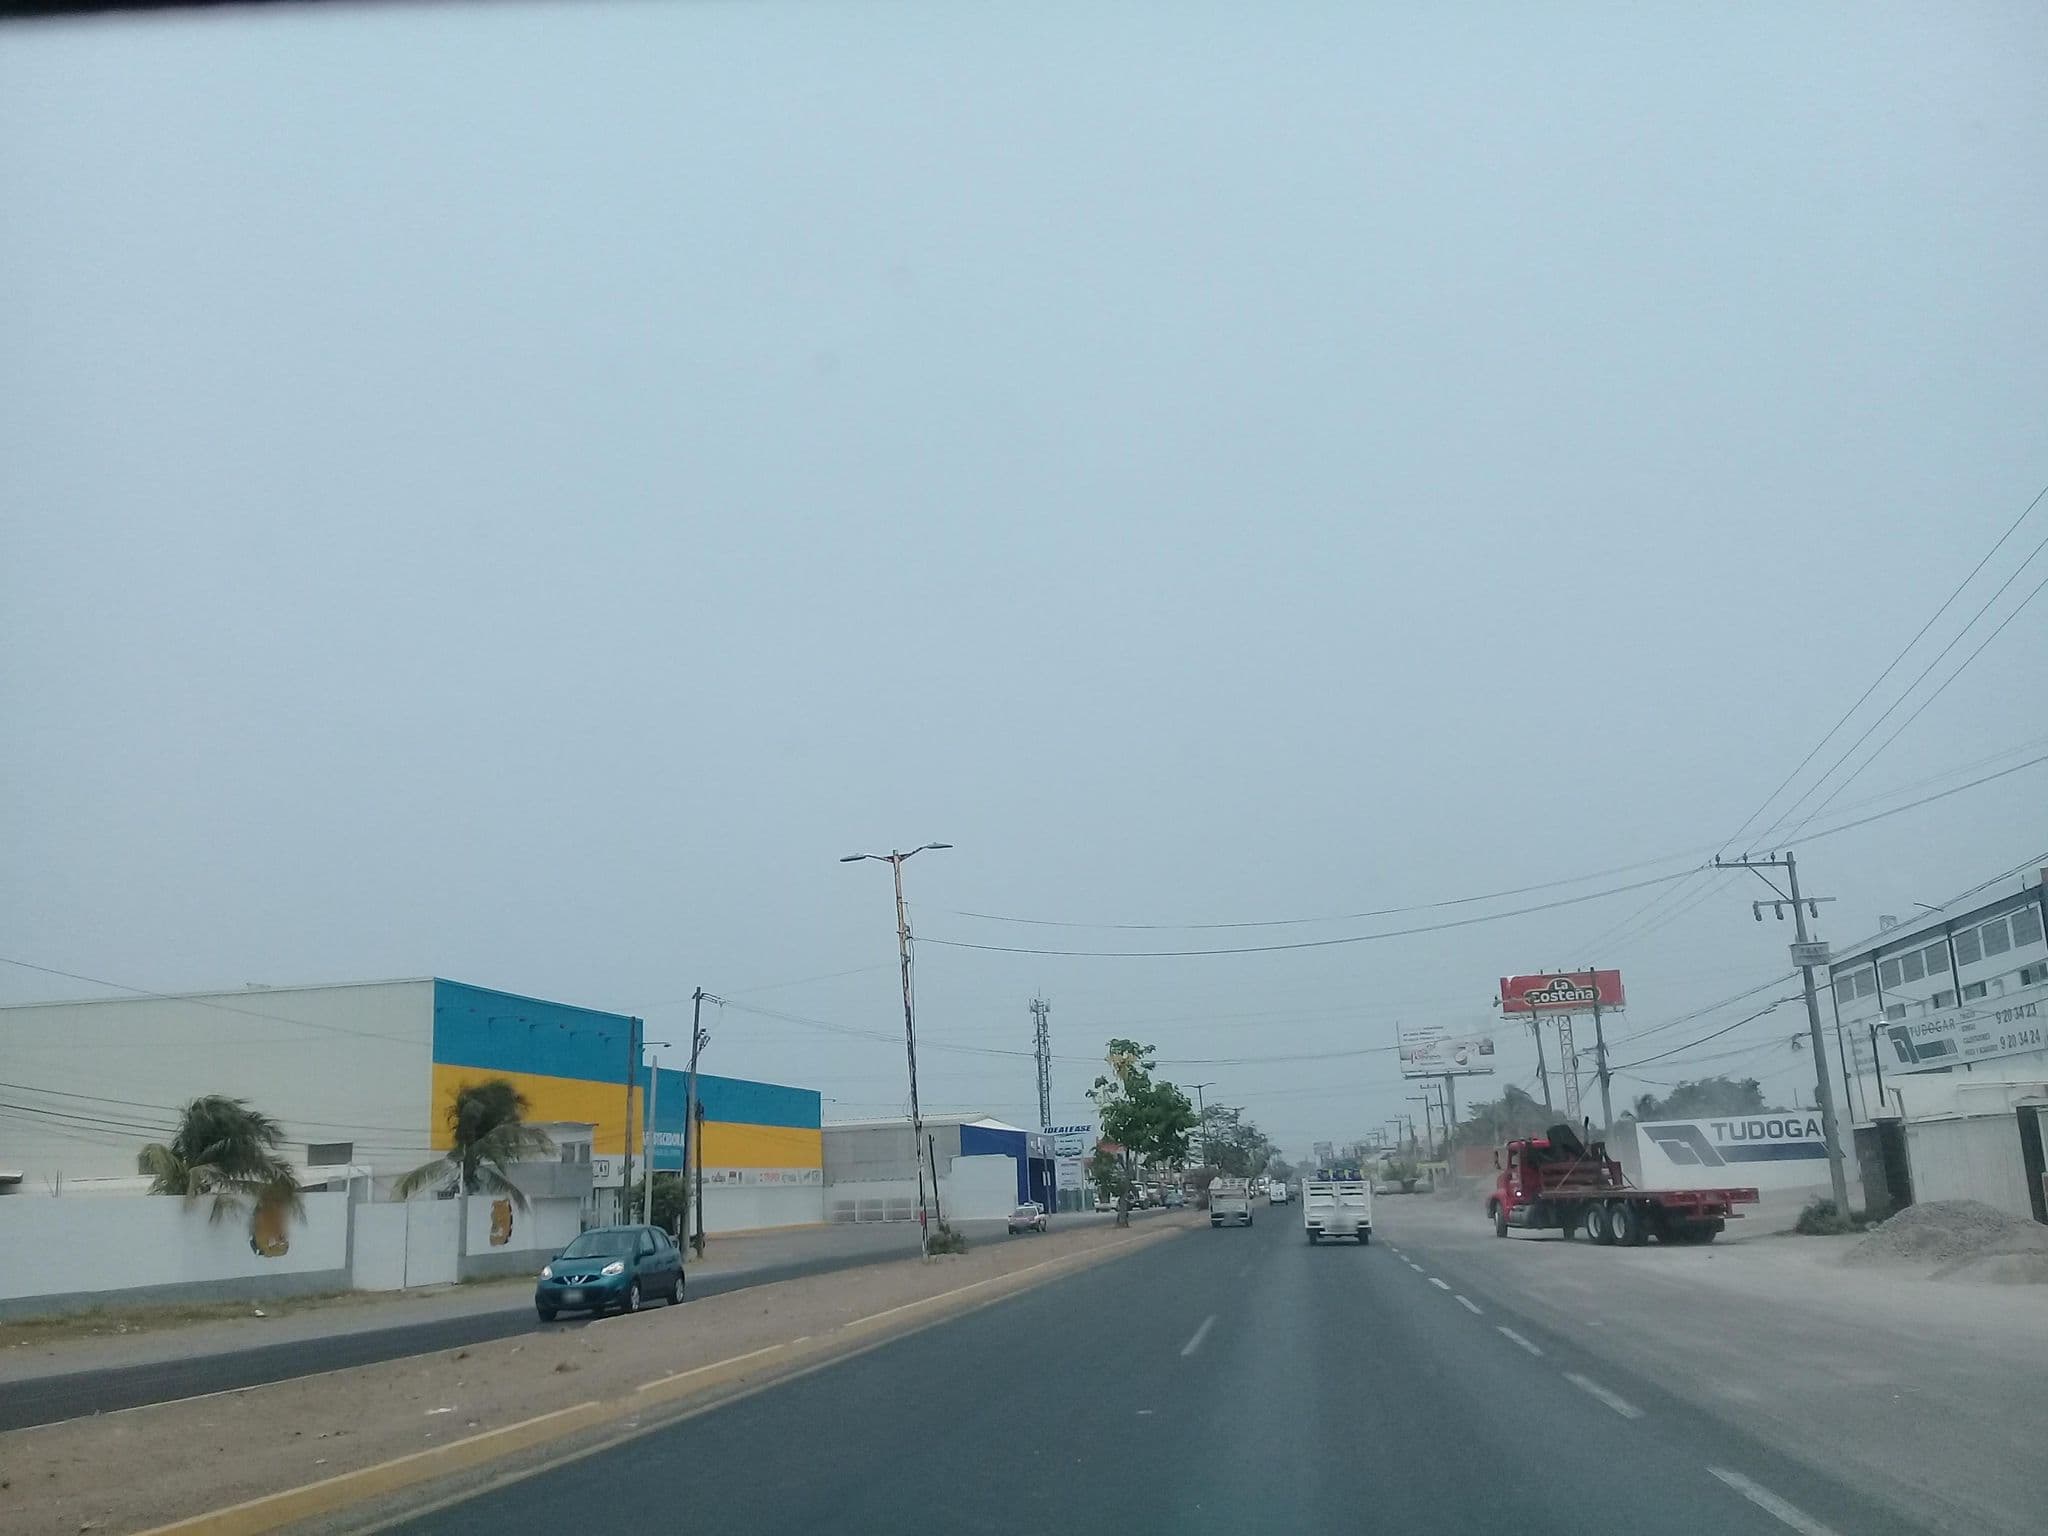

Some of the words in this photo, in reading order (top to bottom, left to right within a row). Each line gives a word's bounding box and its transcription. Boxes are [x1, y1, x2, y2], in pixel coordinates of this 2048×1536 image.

[1554, 981, 1568, 990] La
[1530, 988, 1594, 1003] Costeña
[1909, 1018, 1956, 1037] TUDOGAR
[1044, 1125, 1091, 1134] IDEALEASE
[1710, 1118, 1823, 1141] TUDOGA
